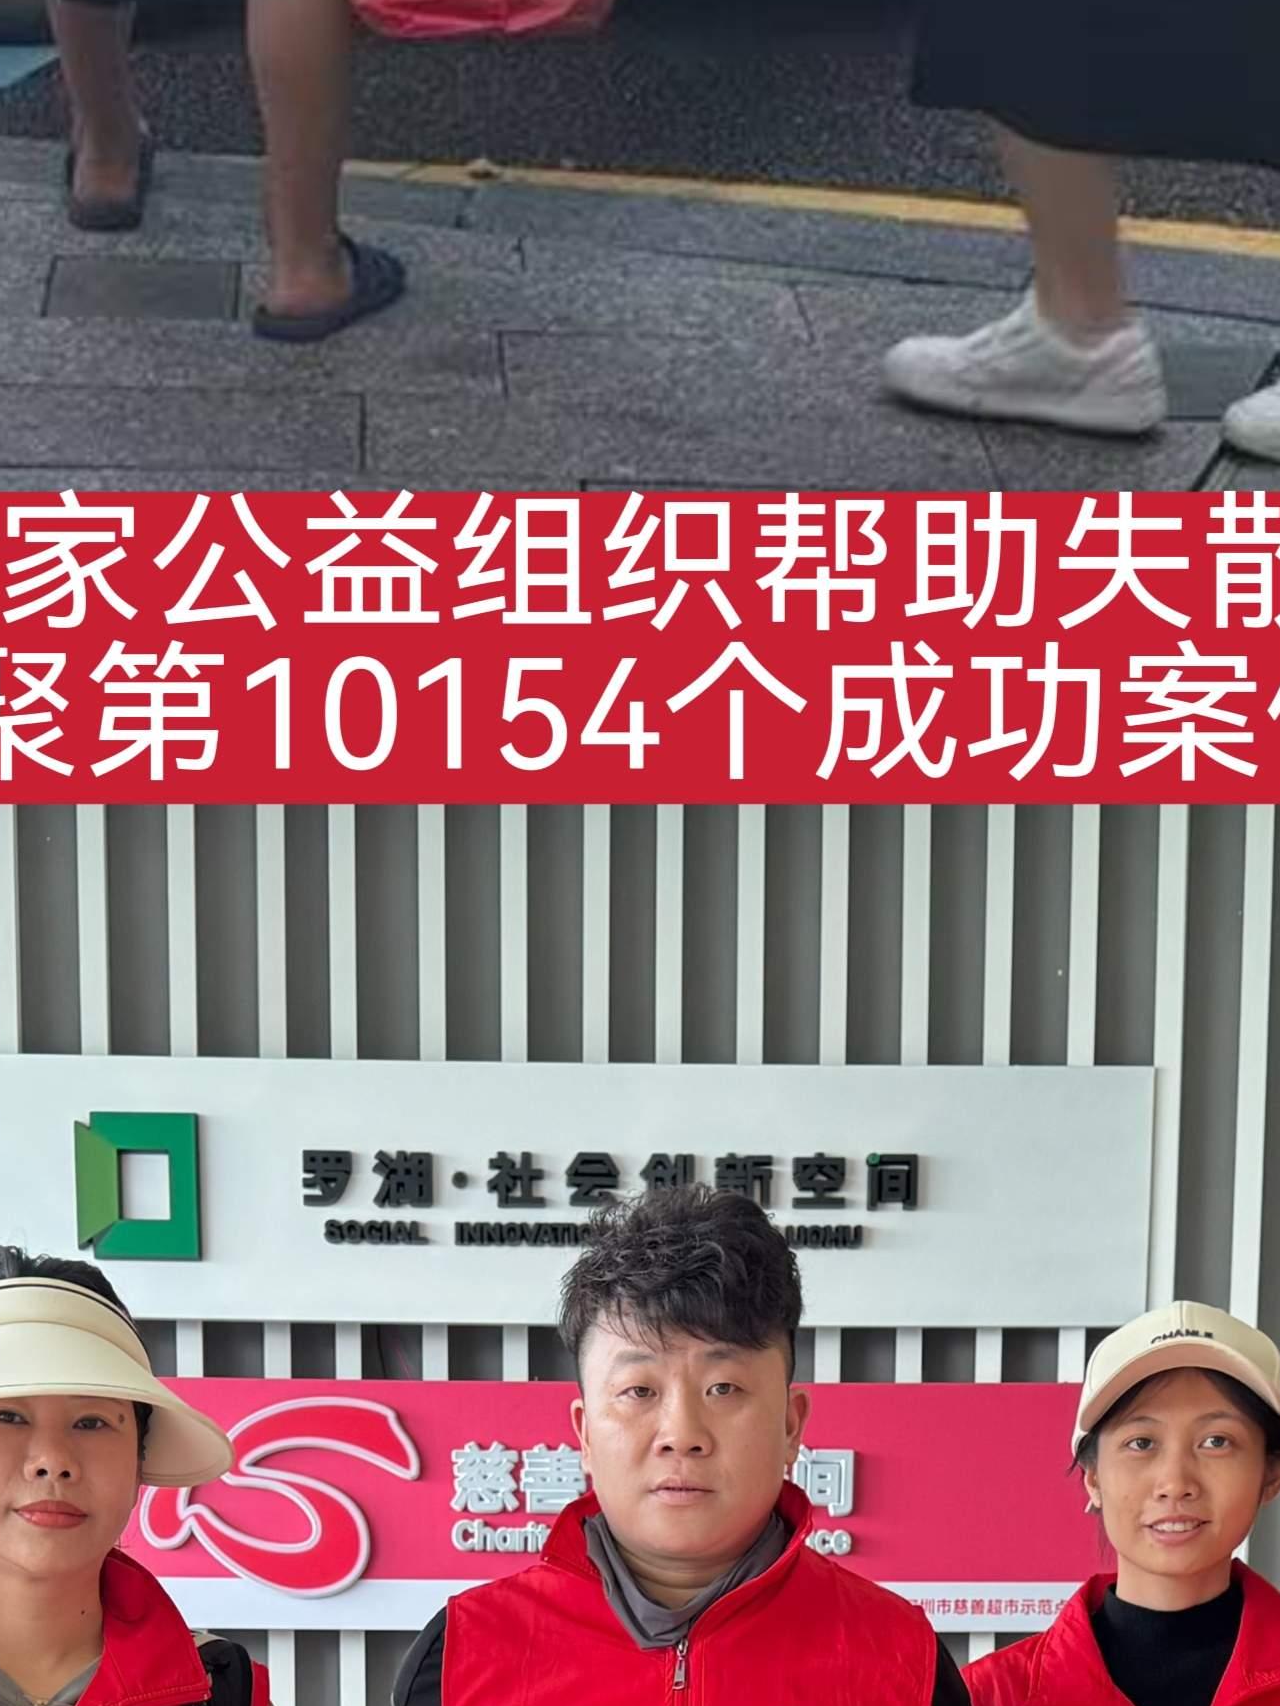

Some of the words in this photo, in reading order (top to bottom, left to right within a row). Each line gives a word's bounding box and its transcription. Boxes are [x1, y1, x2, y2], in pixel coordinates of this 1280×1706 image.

[323, 1219, 430, 1245] SOCIAL
[454, 1221, 604, 1247] INNOVATIO
[451, 1518, 552, 1553] Charit
[911, 1598, 1066, 1615] 圳市慈善超市示范
